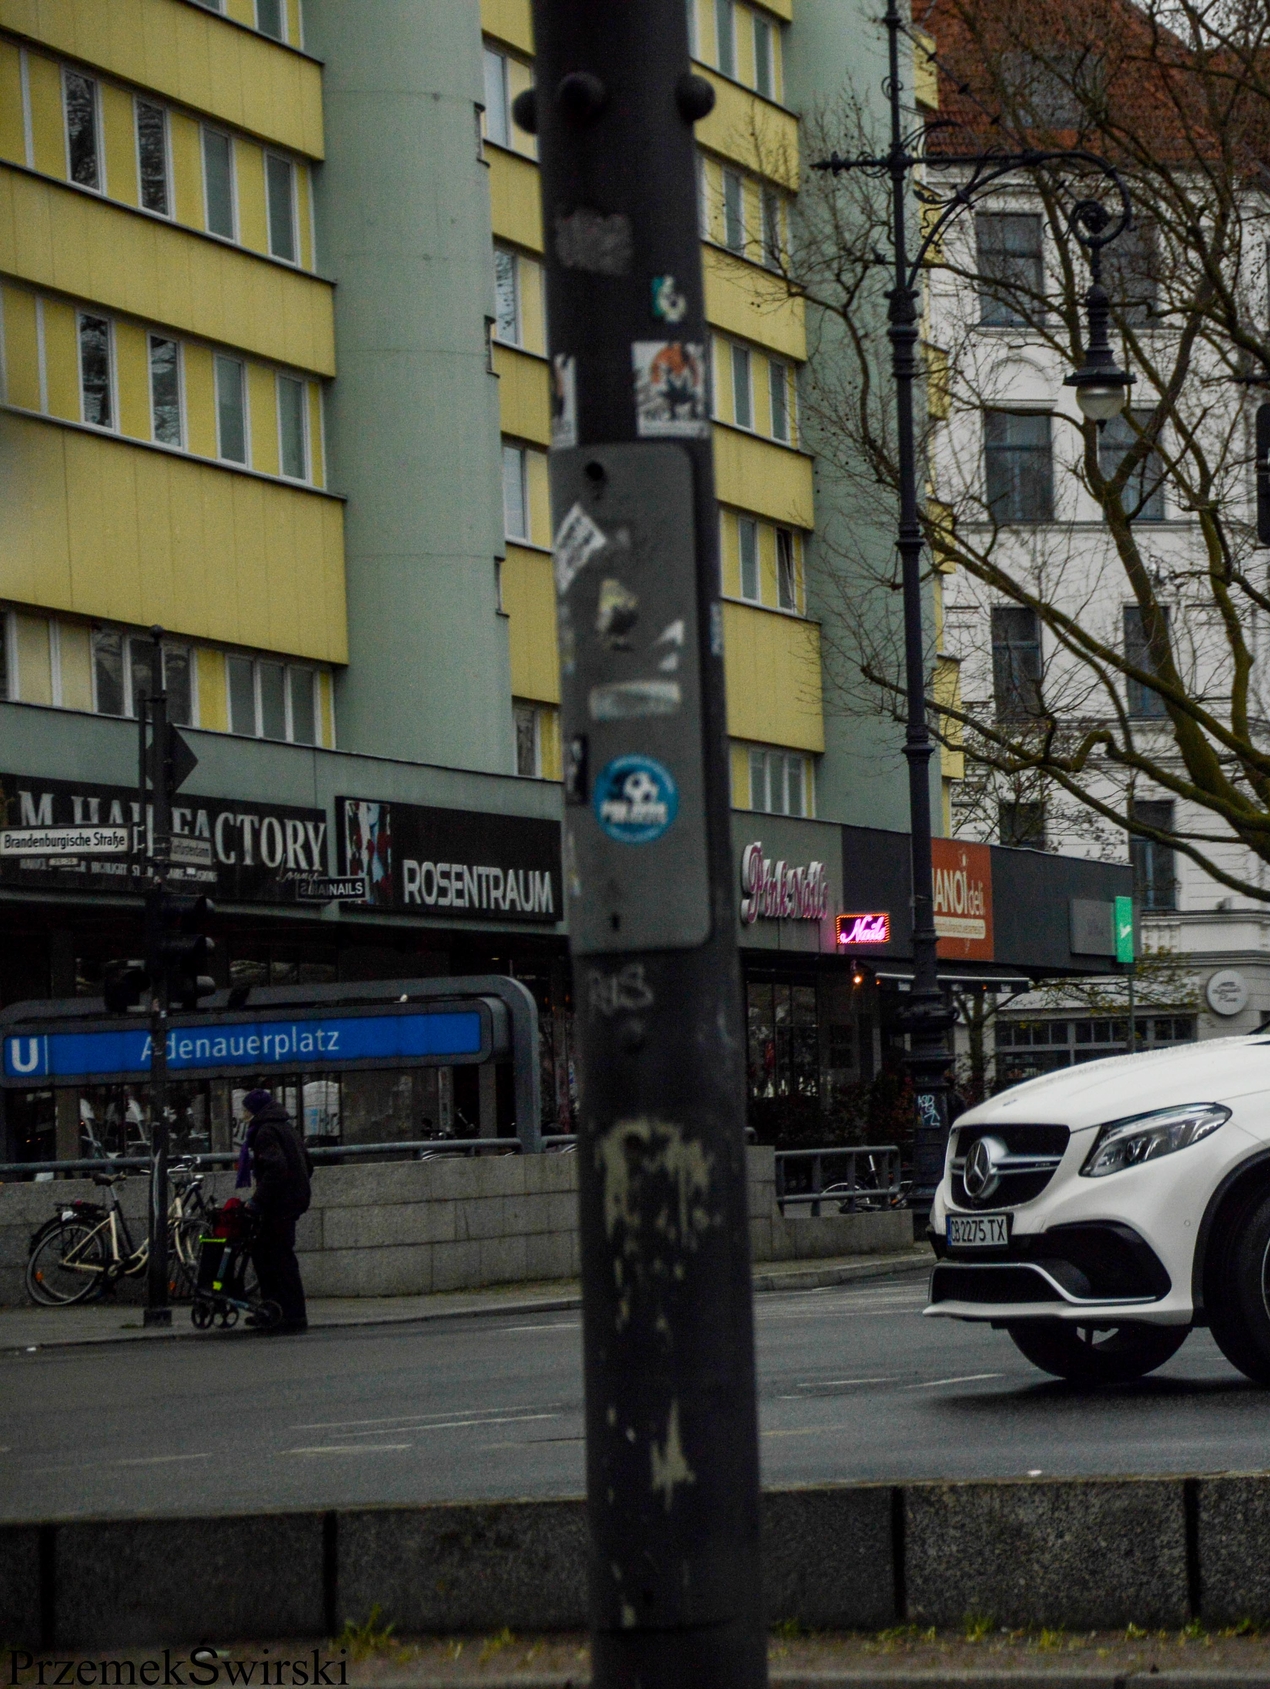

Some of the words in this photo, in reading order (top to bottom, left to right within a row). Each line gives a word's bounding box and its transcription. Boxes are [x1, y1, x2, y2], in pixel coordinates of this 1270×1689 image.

[4, 831, 91, 850] Brandenburgische
[93, 830, 126, 849] Straße
[171, 807, 326, 871] FACTORY
[329, 882, 364, 896] NAILS
[403, 859, 554, 914] ROSENTRAUM
[741, 841, 788, 924] Pink
[786, 861, 829, 920] Nails
[841, 914, 887, 944] Nails
[10, 1038, 39, 1073] U
